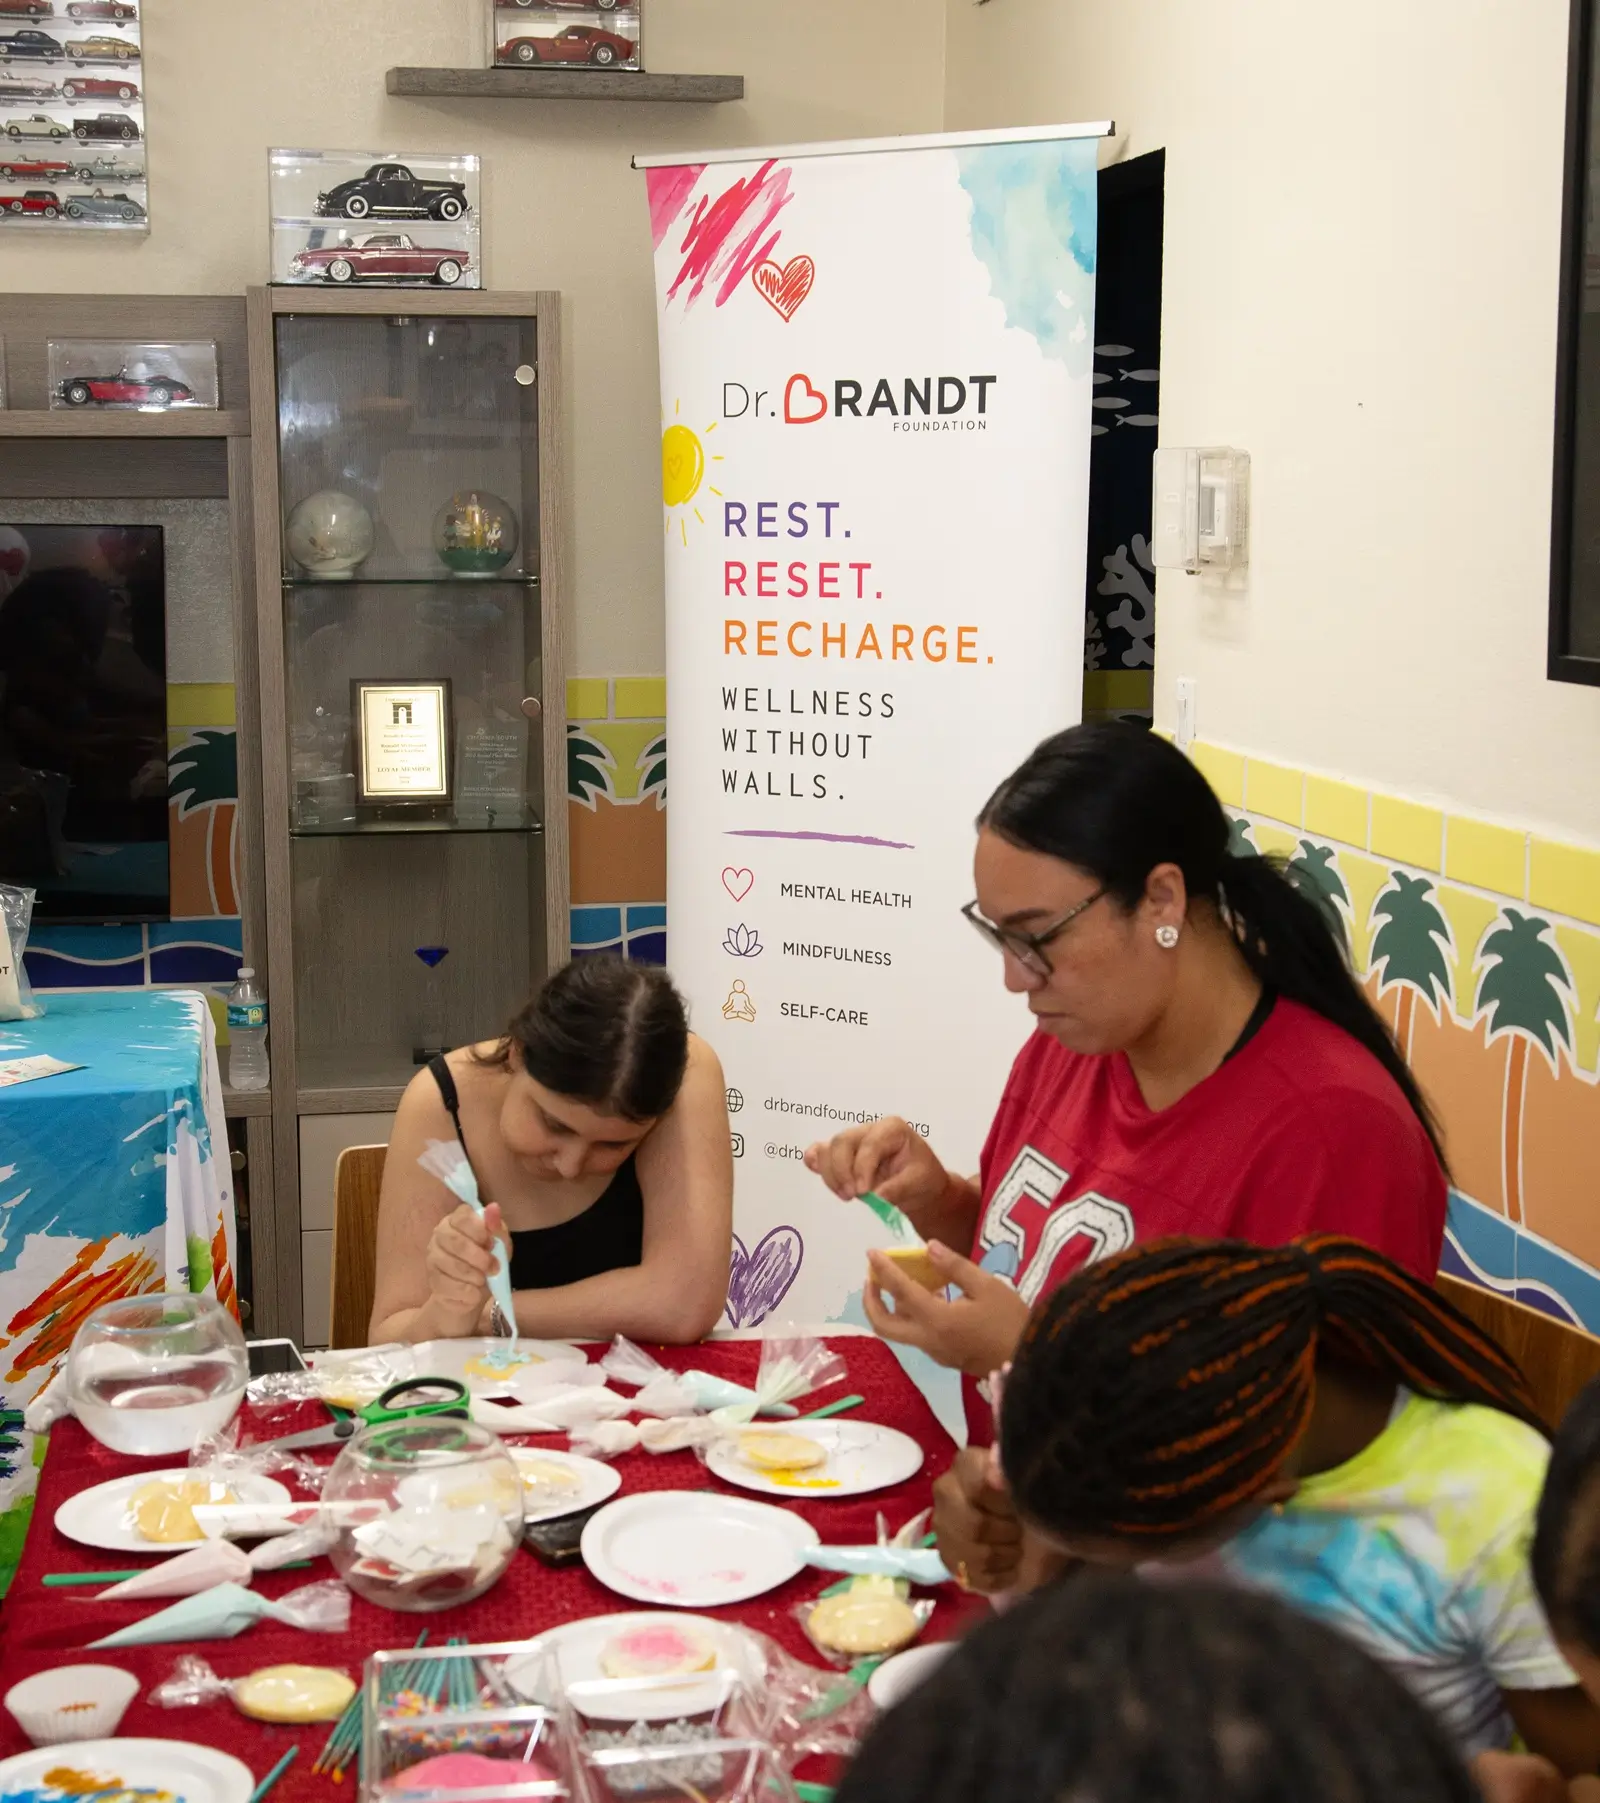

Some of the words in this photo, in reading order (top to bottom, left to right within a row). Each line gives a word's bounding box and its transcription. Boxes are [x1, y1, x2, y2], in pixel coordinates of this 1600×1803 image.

[724, 383, 775, 418] Dr.
[893, 420, 988, 433] FOUNDATION
[725, 502, 850, 538] REST.
[725, 561, 882, 599] RESET.
[725, 620, 993, 664] RECHARGE.
[722, 687, 893, 718] WELLNESS
[722, 728, 872, 759] WITHOUT
[722, 769, 843, 800] WALLS.
[781, 883, 845, 901] MENTAL
[852, 889, 911, 908] HEALTH
[784, 942, 891, 966] MINDFULNESS
[781, 1002, 869, 1027] SELF-CARE
